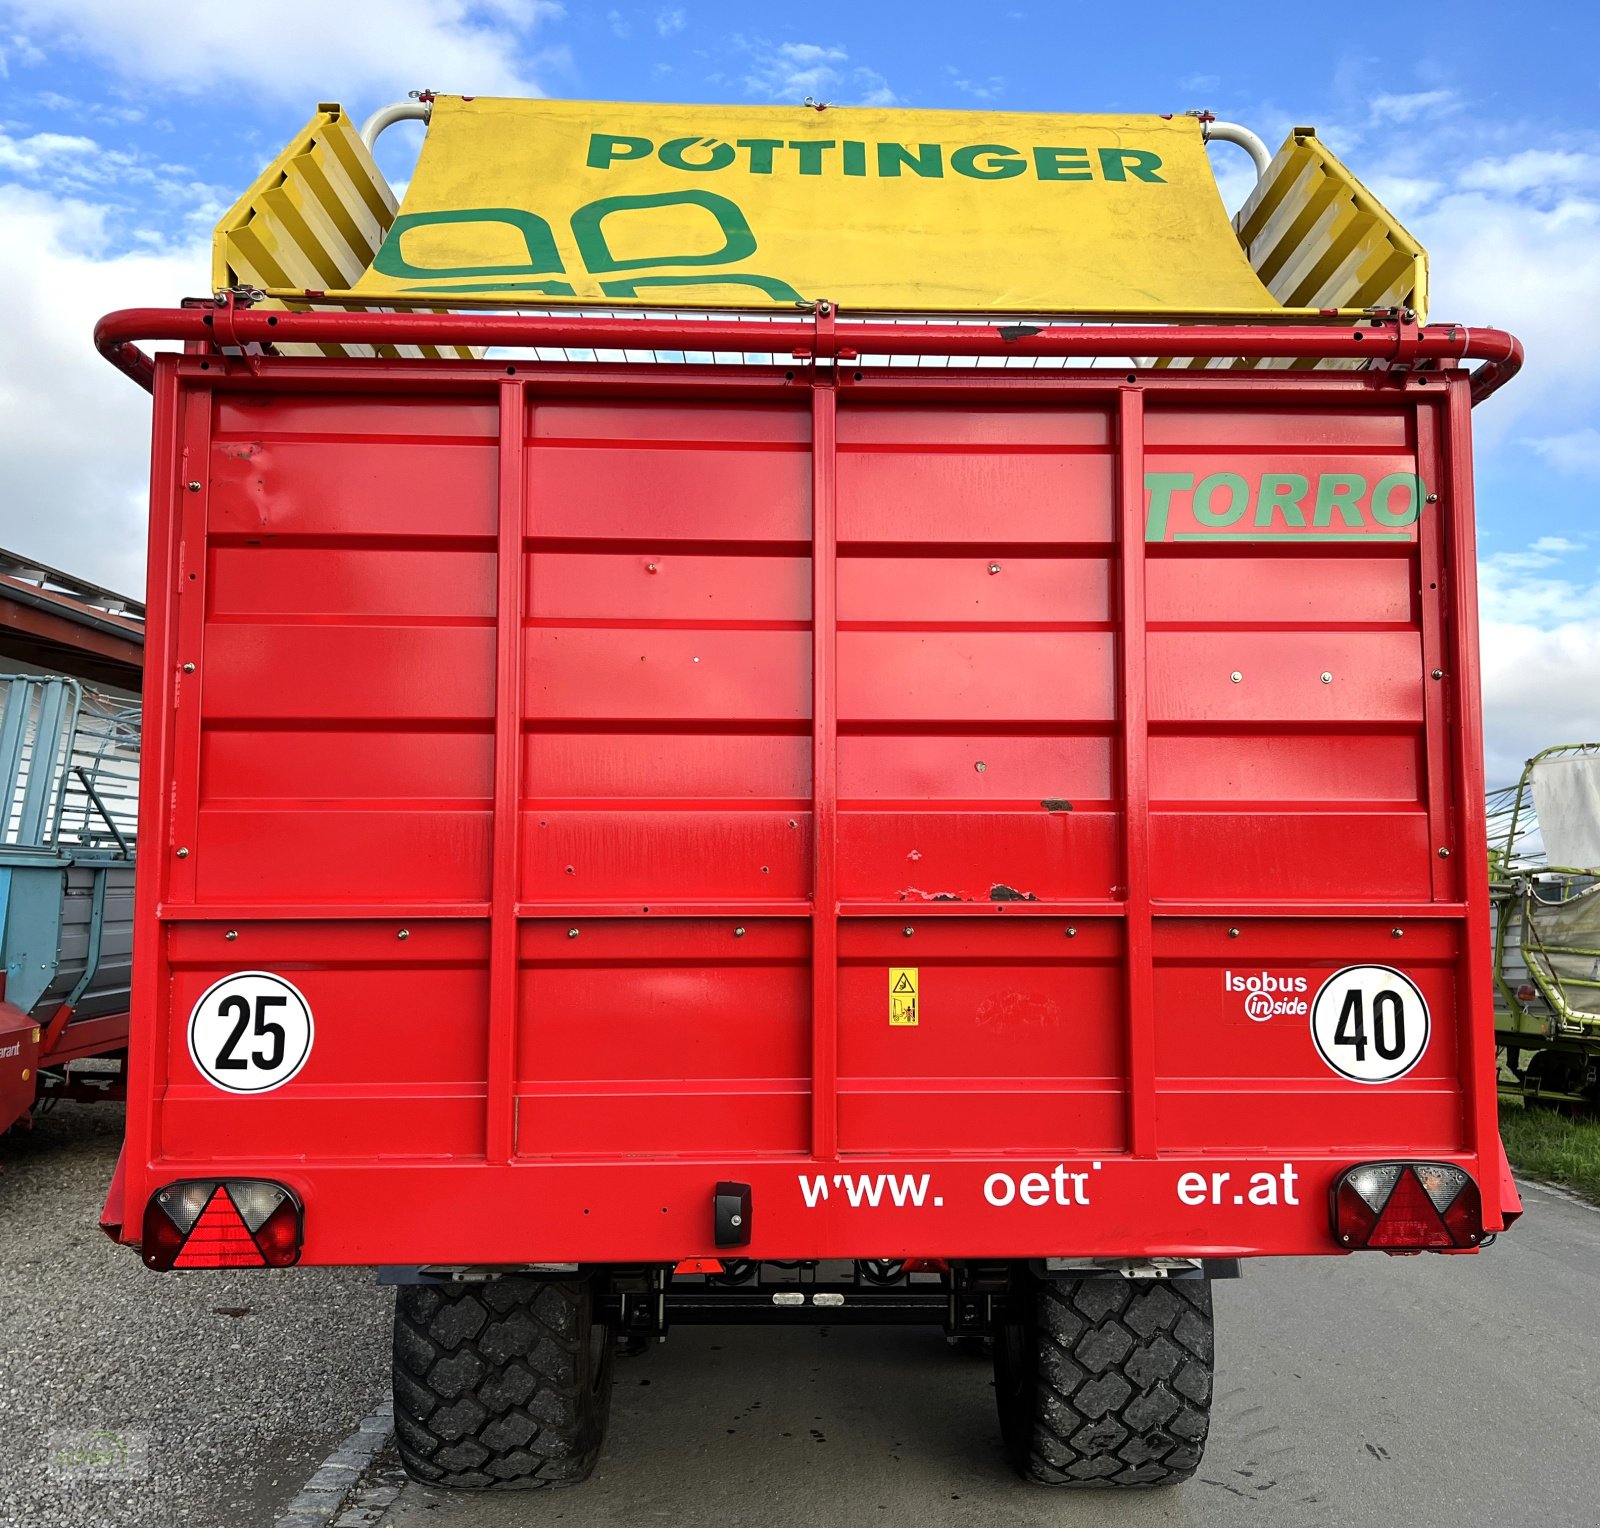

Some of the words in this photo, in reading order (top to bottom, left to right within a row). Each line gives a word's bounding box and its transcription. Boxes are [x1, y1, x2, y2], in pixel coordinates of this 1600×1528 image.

[586, 133, 1167, 183] PÖTTINGER
[1144, 472, 1427, 542] TORRO
[1225, 971, 1308, 992] Isobus
[215, 994, 288, 1071] 25
[1333, 989, 1406, 1061] 40
